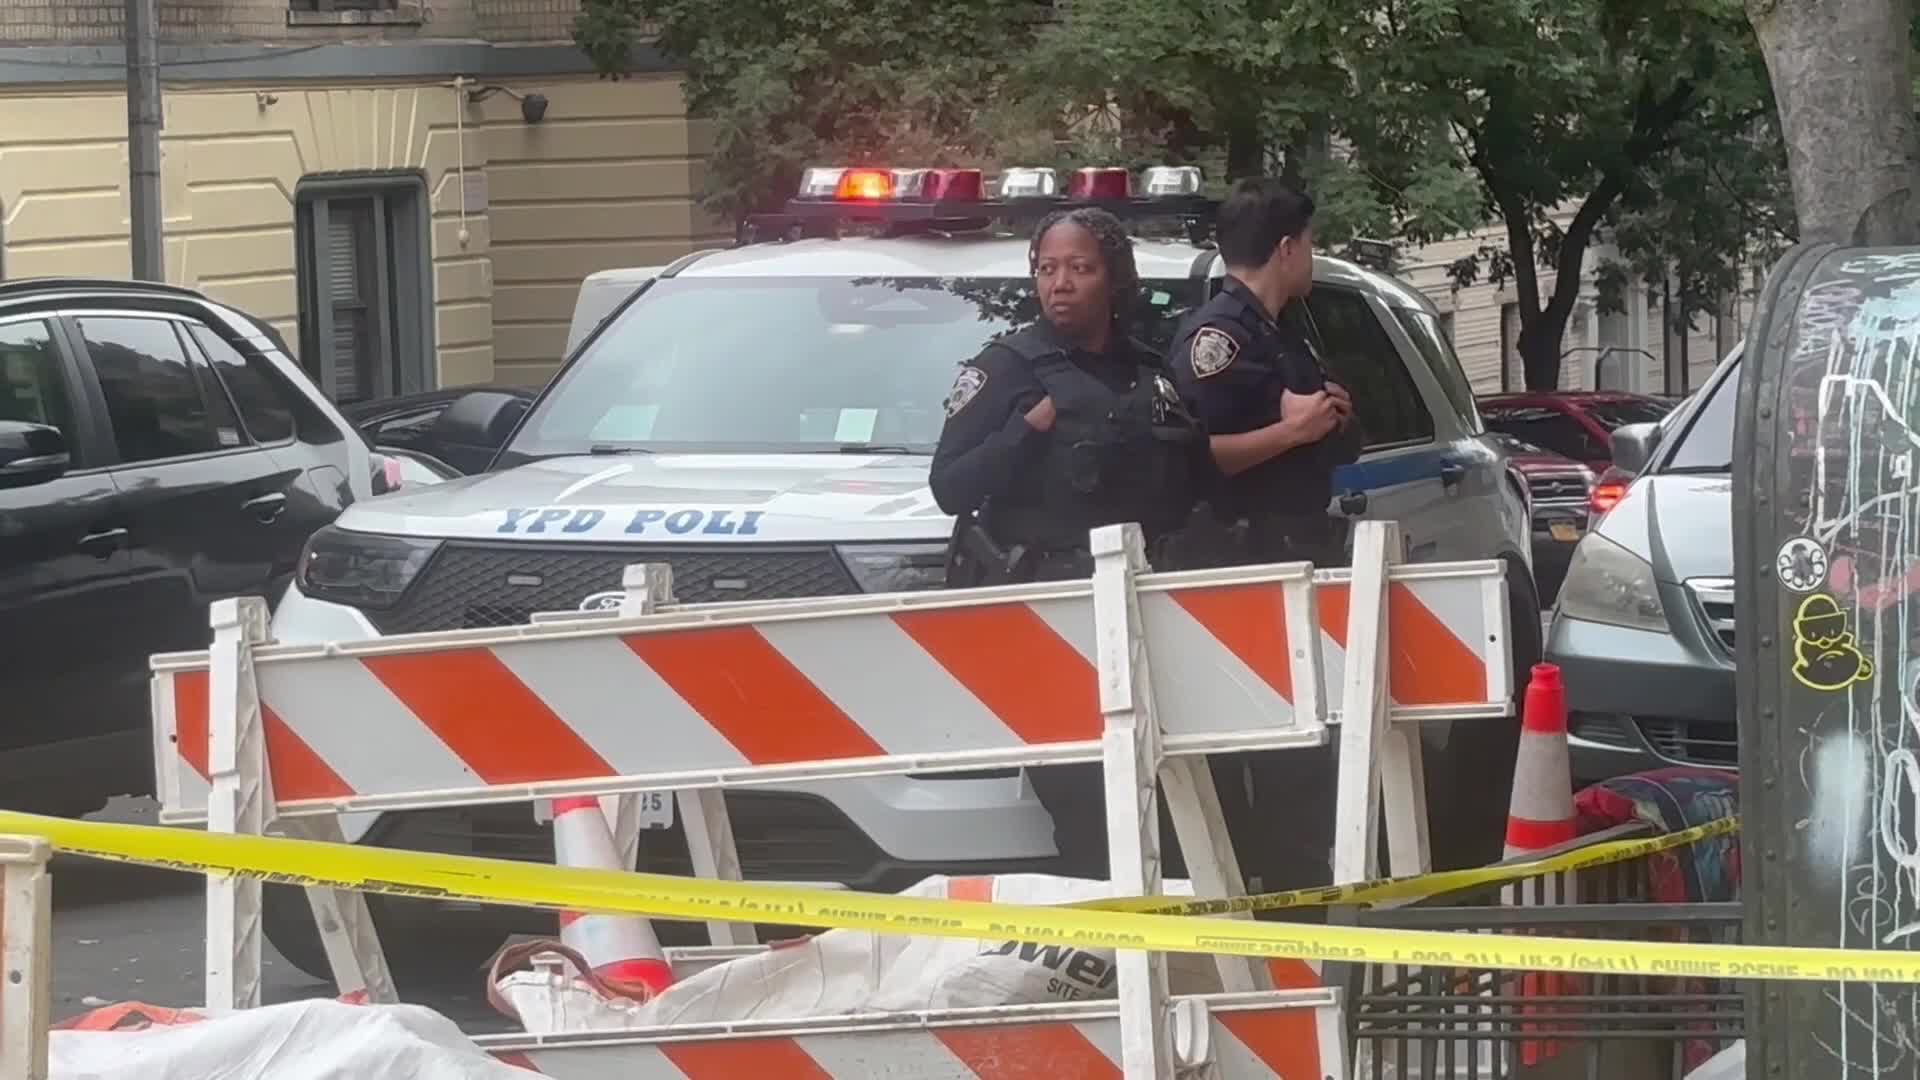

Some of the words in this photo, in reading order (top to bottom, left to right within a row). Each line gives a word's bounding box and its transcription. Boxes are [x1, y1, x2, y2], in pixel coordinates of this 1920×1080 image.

[497, 508, 606, 534] YPD
[624, 510, 767, 535] POLI
[1046, 977, 1081, 1000] SITE
